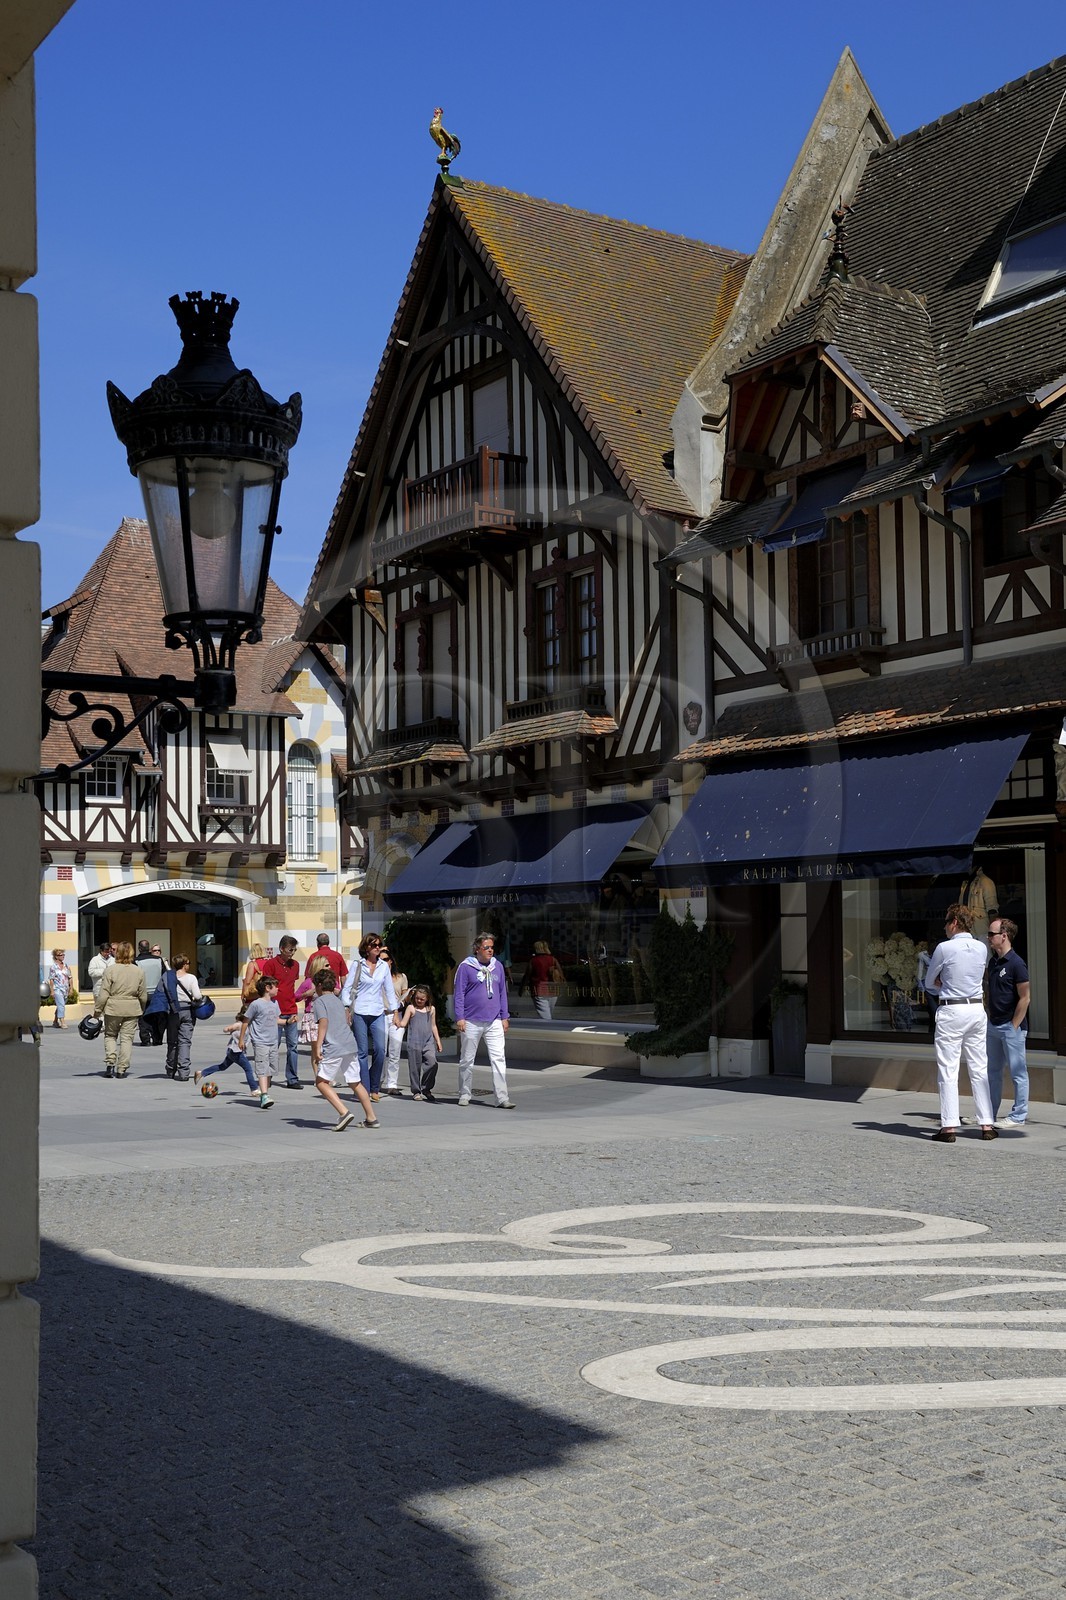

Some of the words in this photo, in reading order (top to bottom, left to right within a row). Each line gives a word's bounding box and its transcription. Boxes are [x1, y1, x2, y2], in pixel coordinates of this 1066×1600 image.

[743, 866, 787, 880] RALPH
[797, 862, 854, 877] LAUREN
[157, 880, 206, 890] HERMES
[451, 895, 479, 905] RALPH
[484, 892, 520, 904] LAUREN
[867, 989, 926, 1005] RALPH
